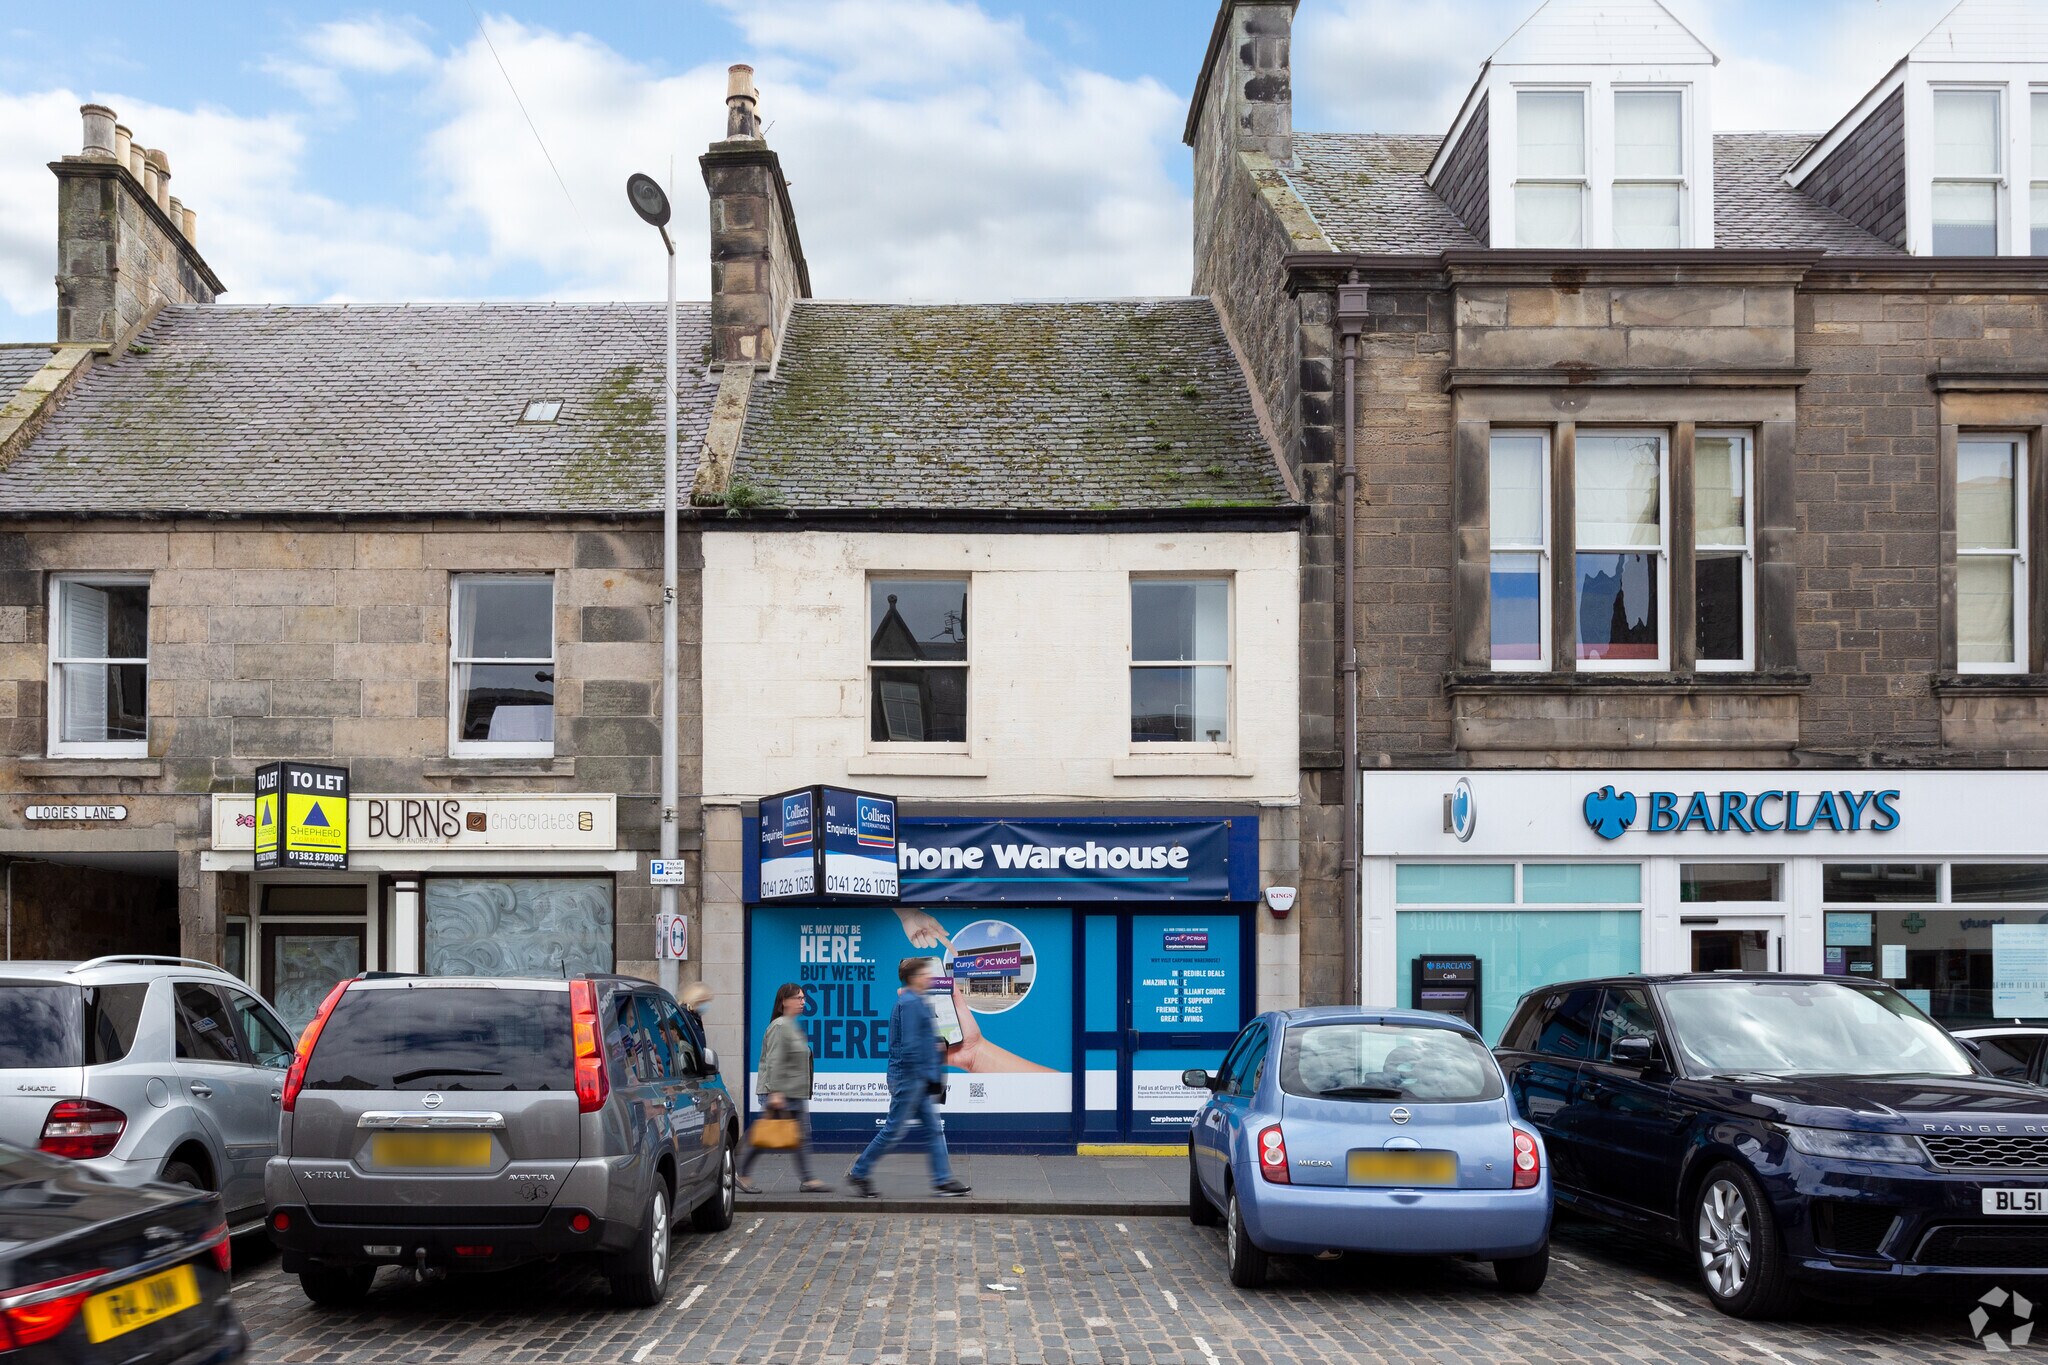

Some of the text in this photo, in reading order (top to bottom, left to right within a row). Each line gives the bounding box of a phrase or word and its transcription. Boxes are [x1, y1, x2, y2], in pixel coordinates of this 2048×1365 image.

[258, 771, 278, 790] TO LET
[291, 771, 344, 791] TO LET
[35, 806, 116, 819] LOGIES LANE
[368, 799, 575, 838] BURNS Chocolates
[786, 803, 809, 820] Colliers
[826, 805, 836, 817] All
[861, 806, 891, 823] Colliers
[1648, 790, 1901, 833] BARCLAYS
[290, 826, 341, 838] SHEPHERD
[826, 821, 857, 836] Enquiries
[861, 821, 891, 831] INTERNATIONAL
[762, 829, 783, 844] Enquiries
[289, 851, 344, 863] 01382 878005
[898, 841, 1189, 870] hone Warehouse
[762, 875, 814, 897] 0141 226 1050
[827, 875, 897, 895] 0141 226 1075
[800, 924, 861, 934] WE MAY NOT BE
[800, 935, 876, 963] HERE...
[955, 956, 1018, 968] Currys PC World
[800, 965, 876, 981] BUT WE'RE
[1207, 969, 1225, 977] DEALS
[802, 983, 879, 1017] STILL
[803, 1019, 890, 1060] HERE
[813, 1082, 828, 1091] Find
[845, 1082, 867, 1092] Currys
[867, 1082, 877, 1091] PC
[1923, 1124, 2008, 1133] RANGE
[1298, 1159, 1333, 1167] MICRA
[303, 1171, 351, 1179] X-TRAIL
[508, 1173, 556, 1181] AVENTURA
